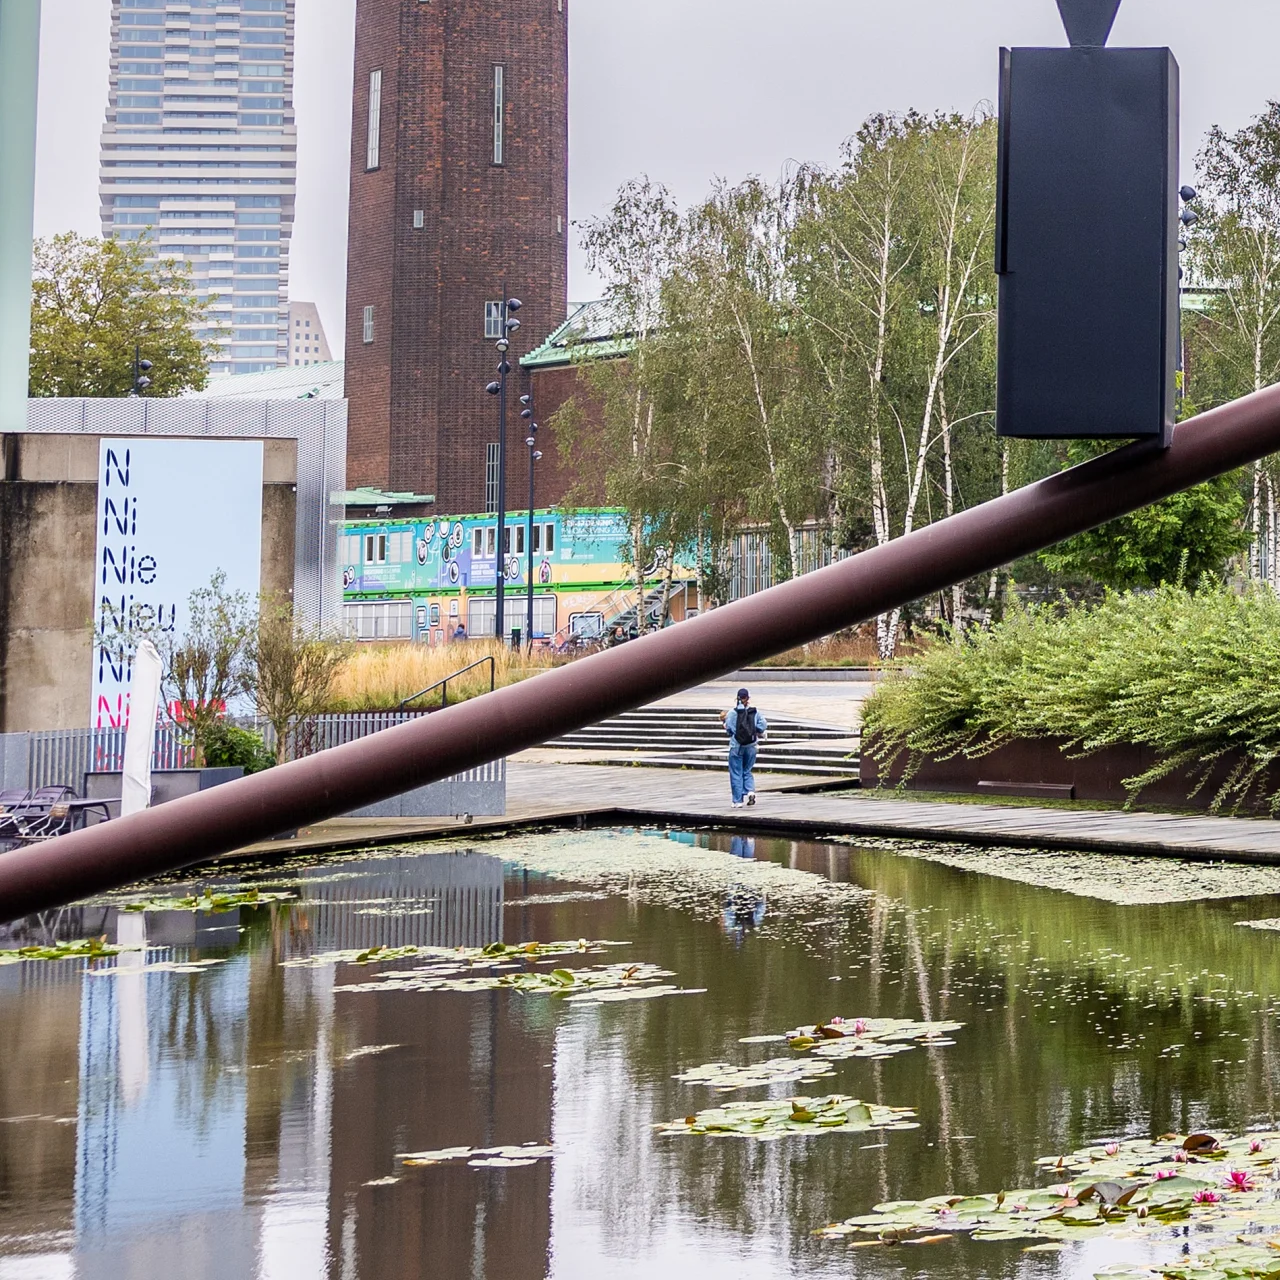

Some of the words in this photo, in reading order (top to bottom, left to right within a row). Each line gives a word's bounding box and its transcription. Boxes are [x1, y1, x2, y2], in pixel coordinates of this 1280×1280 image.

[106, 448, 130, 487] N
[104, 497, 137, 536] Ni
[103, 545, 157, 585] Nie
[101, 594, 176, 635] Nieu
